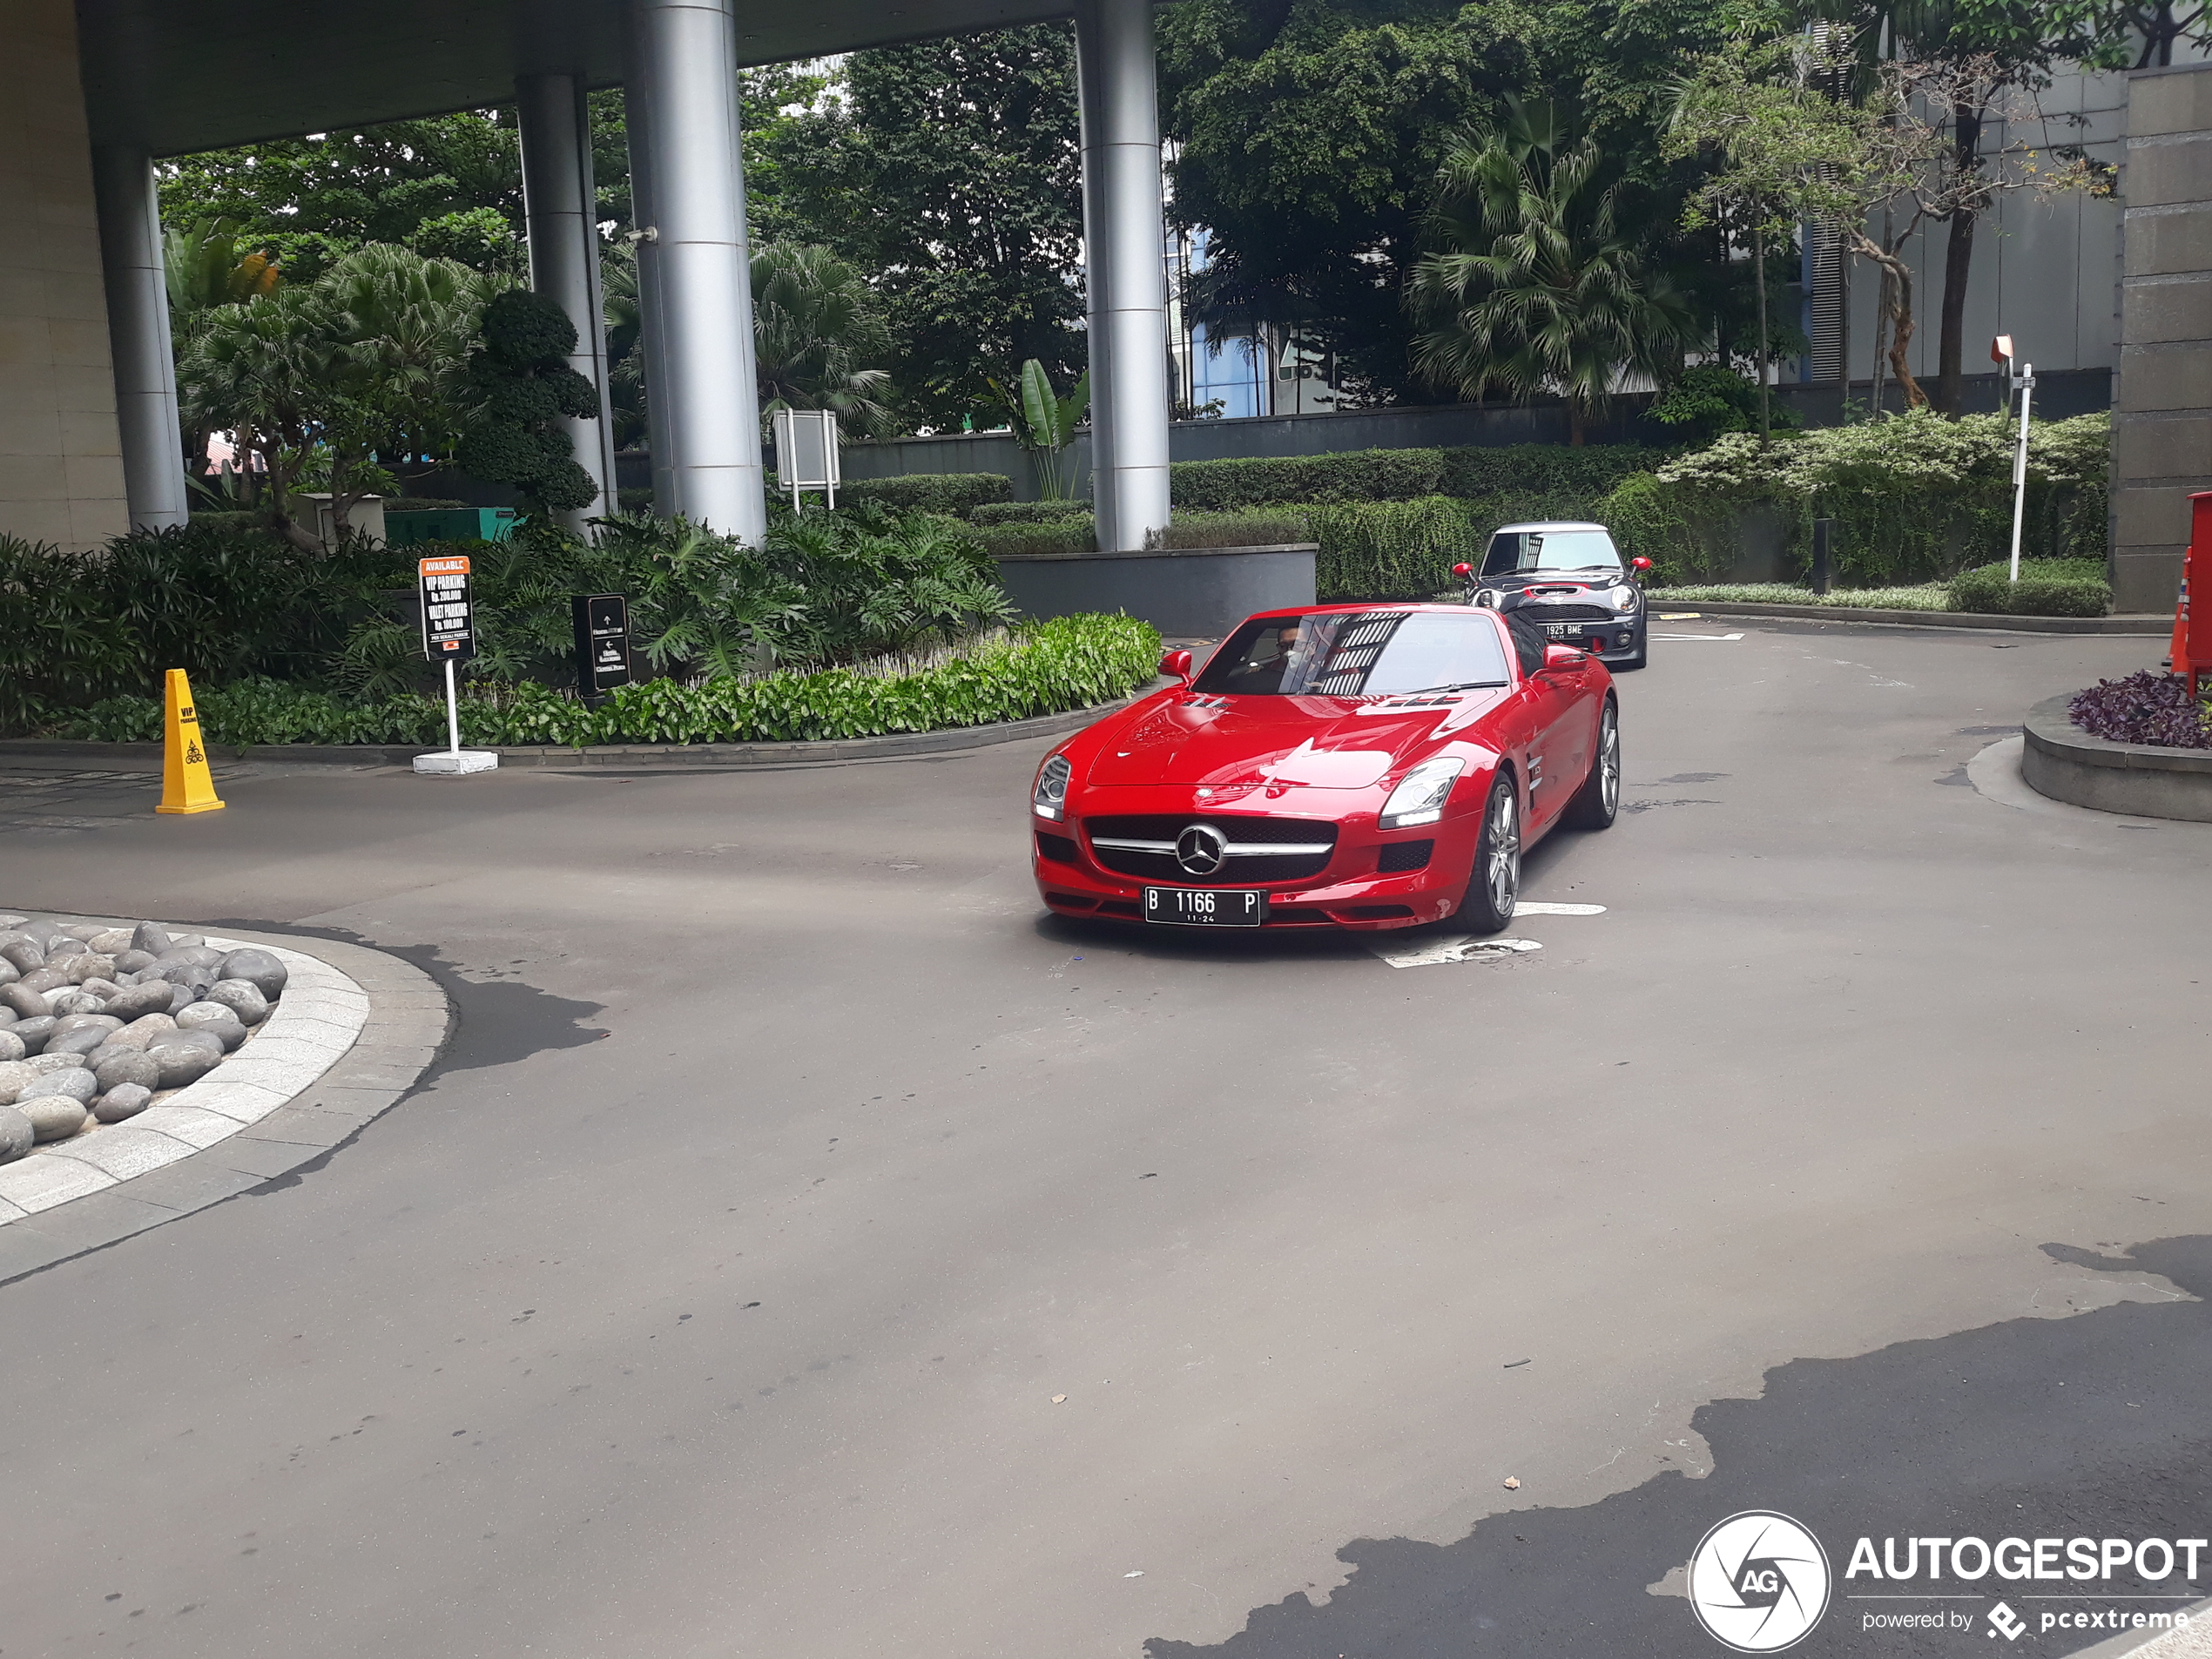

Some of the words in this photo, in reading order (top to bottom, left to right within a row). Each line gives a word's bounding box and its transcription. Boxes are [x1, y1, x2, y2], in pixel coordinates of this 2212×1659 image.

[426, 560, 464, 571] AVAILABLE
[426, 576, 437, 591] VIP
[437, 574, 466, 590] PARKING
[428, 604, 444, 620] VALET
[444, 602, 469, 618] PARKING
[1547, 625, 1564, 635] 1925
[1568, 625, 1582, 634] BME
[181, 707, 193, 717] VIP
[1149, 889, 1159, 910] B
[1177, 891, 1216, 914] 1166
[1244, 893, 1256, 914] P
